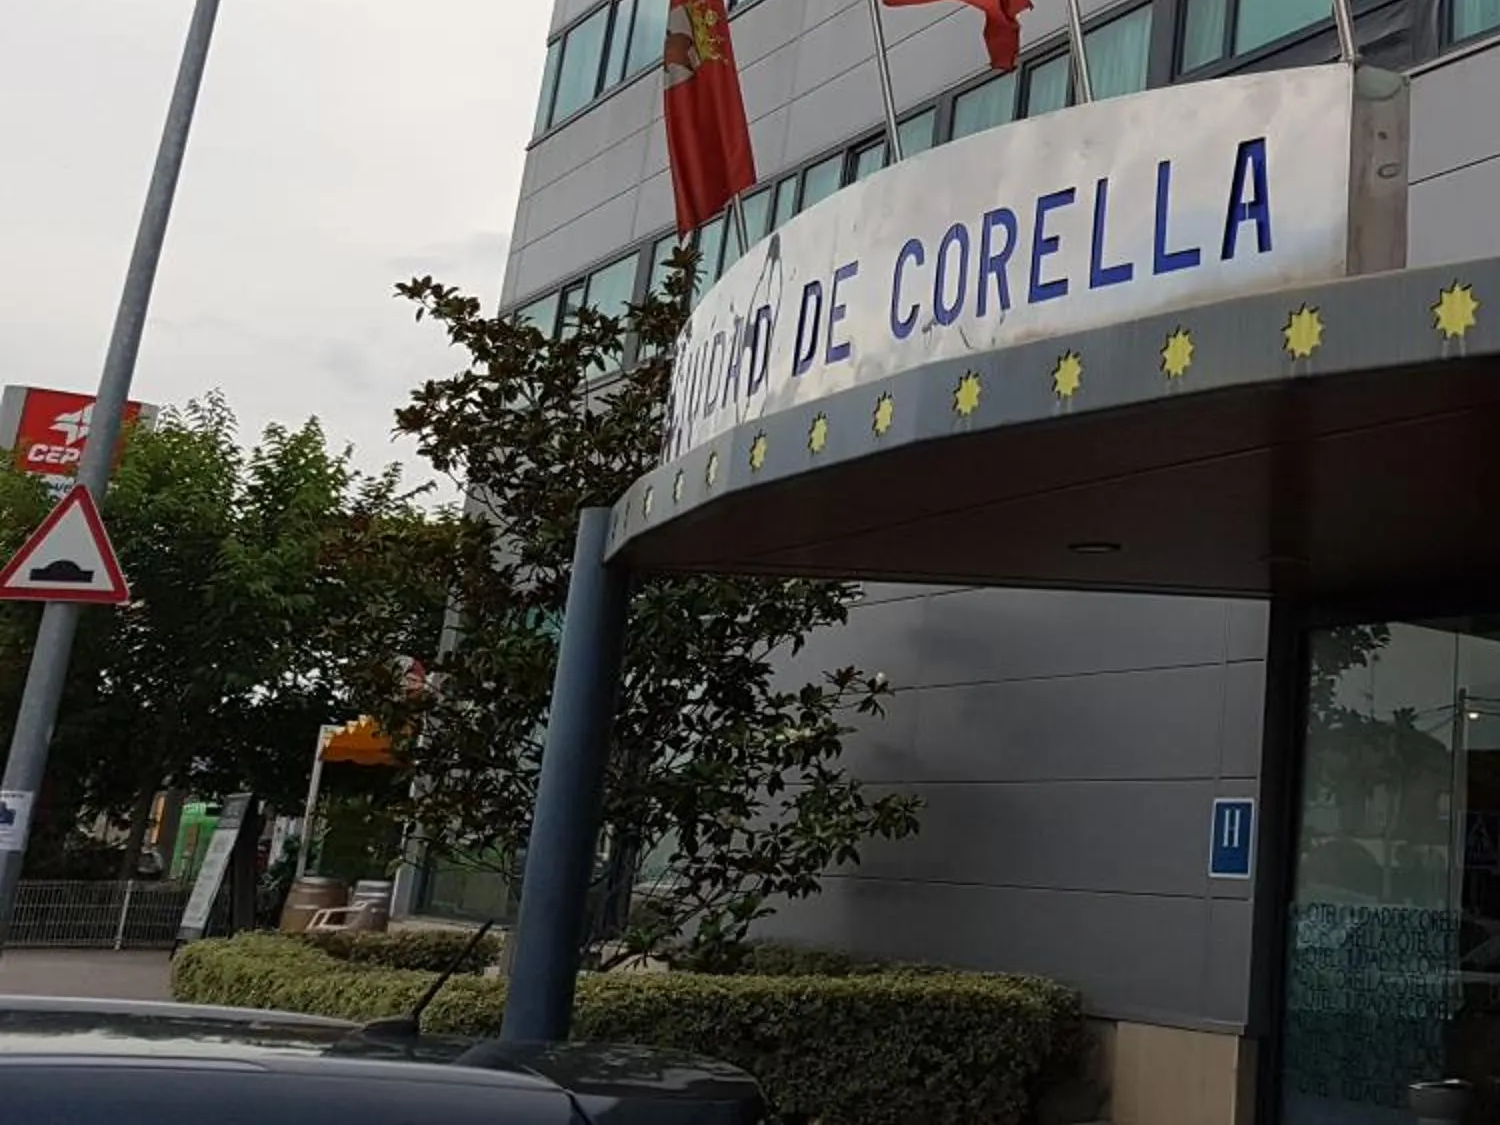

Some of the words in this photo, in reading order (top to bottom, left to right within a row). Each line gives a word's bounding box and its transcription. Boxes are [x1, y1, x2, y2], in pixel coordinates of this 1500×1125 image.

[791, 259, 859, 378] DE
[890, 136, 1274, 341] CORELLA
[27, 443, 81, 465] CEP
[1222, 809, 1240, 848] H
